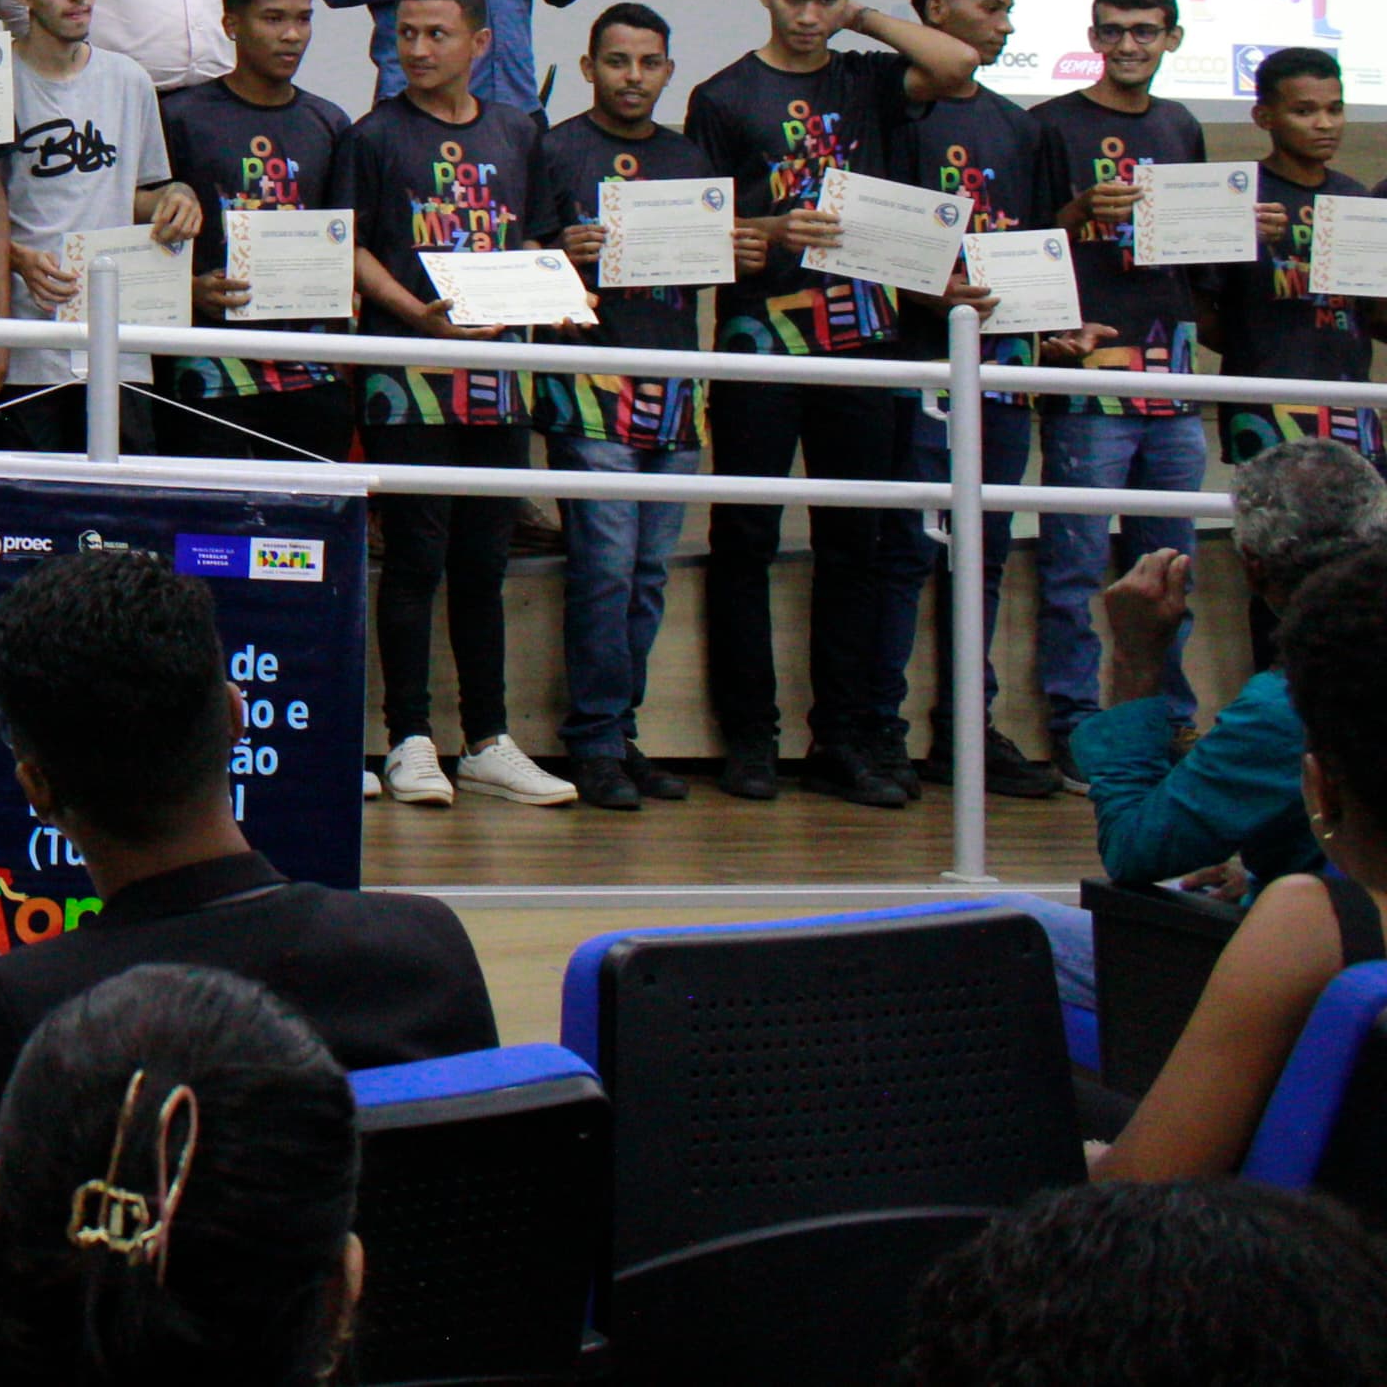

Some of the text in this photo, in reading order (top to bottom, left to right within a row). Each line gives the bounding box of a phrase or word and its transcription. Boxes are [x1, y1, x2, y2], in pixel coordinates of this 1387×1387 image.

[788, 99, 811, 119] o
[250, 135, 272, 157] o
[440, 140, 463, 162] o
[947, 145, 968, 167] o
[1102, 136, 1124, 158] o
[242, 157, 299, 191] por
[614, 153, 638, 176] o
[433, 161, 497, 194] por
[259, 175, 298, 204] tu
[451, 180, 490, 209] tu
[3, 535, 53, 553] proec
[231, 645, 279, 682] de
[287, 699, 310, 730] e
